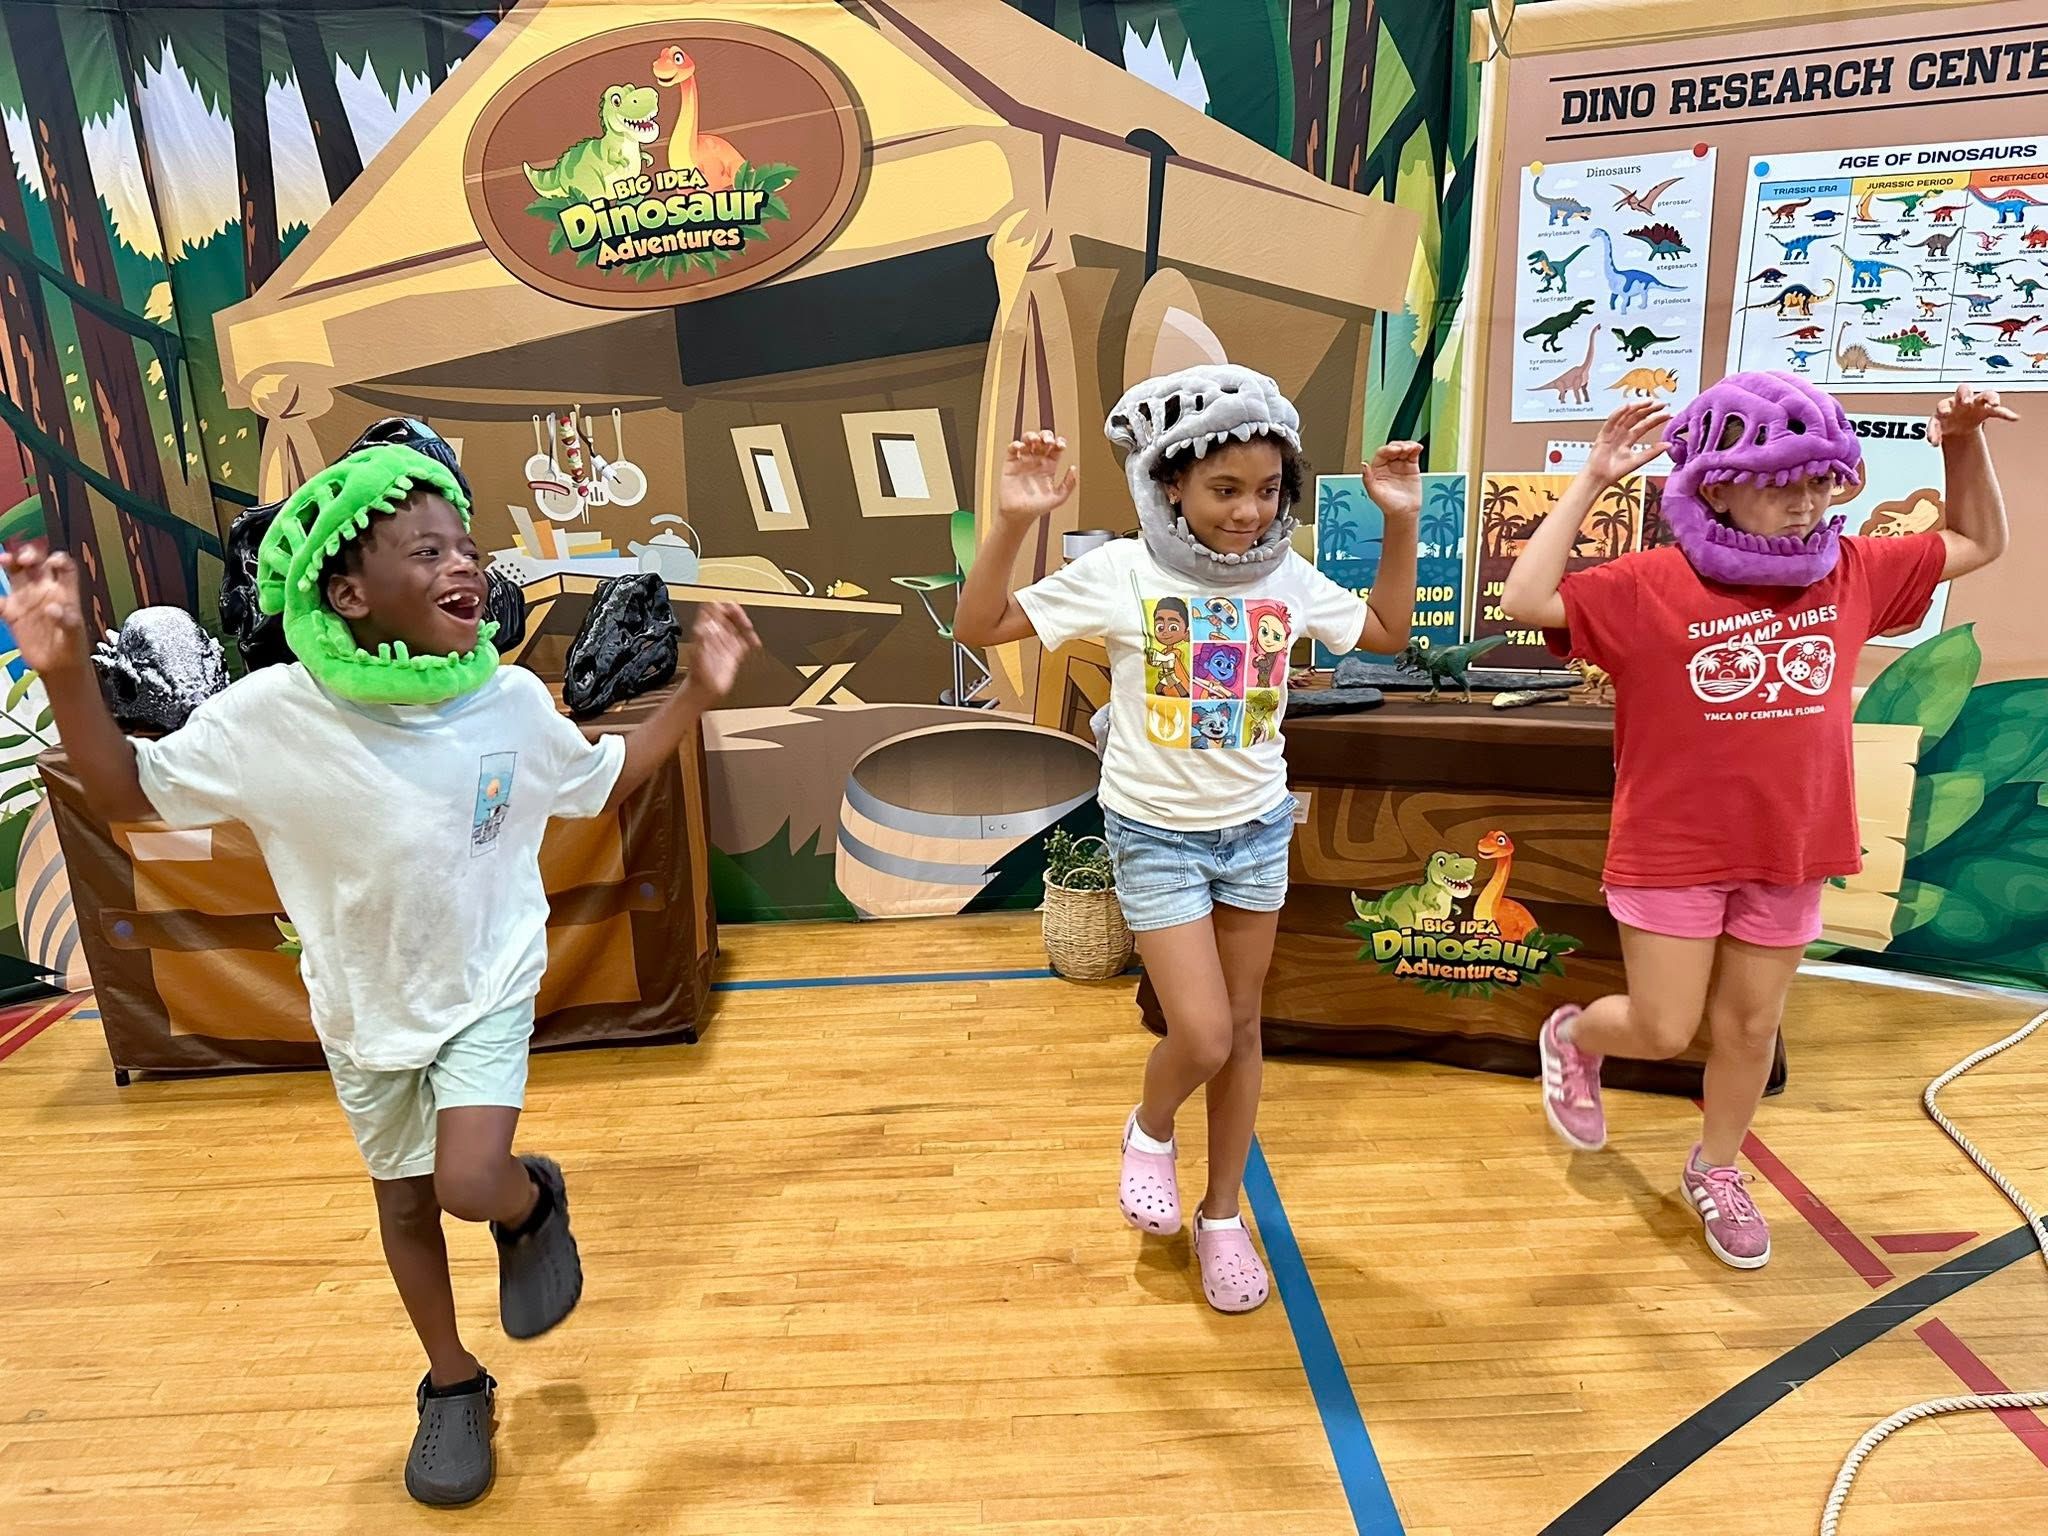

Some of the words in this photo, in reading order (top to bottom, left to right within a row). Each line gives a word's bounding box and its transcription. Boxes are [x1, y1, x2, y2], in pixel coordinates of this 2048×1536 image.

[1560, 81, 1656, 125] DINO
[1669, 56, 1895, 115] RESEARCH
[1838, 155, 1880, 170] AGE
[1885, 153, 1912, 166] OF
[1917, 144, 2038, 164] DINOSAURS
[1586, 164, 1642, 178] Dinosaurs
[613, 175, 651, 201] BIG
[656, 168, 707, 191] IDEA
[1773, 186, 1816, 196] TRIASSIC
[1818, 185, 1838, 193] ERA
[1866, 180, 1914, 190] JURASSIC
[1916, 178, 1954, 187] PERIOD
[1657, 198, 1693, 208] pterosaur
[558, 190, 764, 248] Dinosaur
[1537, 229, 1581, 238] ankylosaurus
[597, 226, 741, 268] Adventures
[1656, 262, 1698, 272] stegosaurus
[1532, 295, 1575, 304] velociraptor
[1653, 298, 1691, 306] diplodocus
[1652, 348, 1693, 356] spinosaurus
[1848, 420, 1927, 440] SSILS
[1416, 586, 1453, 602] RIOD
[1483, 605, 1514, 621] 20
[1687, 608, 1776, 640] SUMMER
[1727, 621, 1783, 651] CAMP
[1788, 605, 1838, 631] VIBES
[1704, 713, 1733, 721] YMCA
[1735, 711, 1749, 720] OF
[1750, 709, 1794, 720] CENTRAL
[1795, 705, 1825, 716] FLORIDA
[1423, 919, 1455, 934] BIG
[1460, 919, 1500, 935] IDEA
[1371, 928, 1548, 971] Dinosaur
[1395, 957, 1519, 983] Adventures
